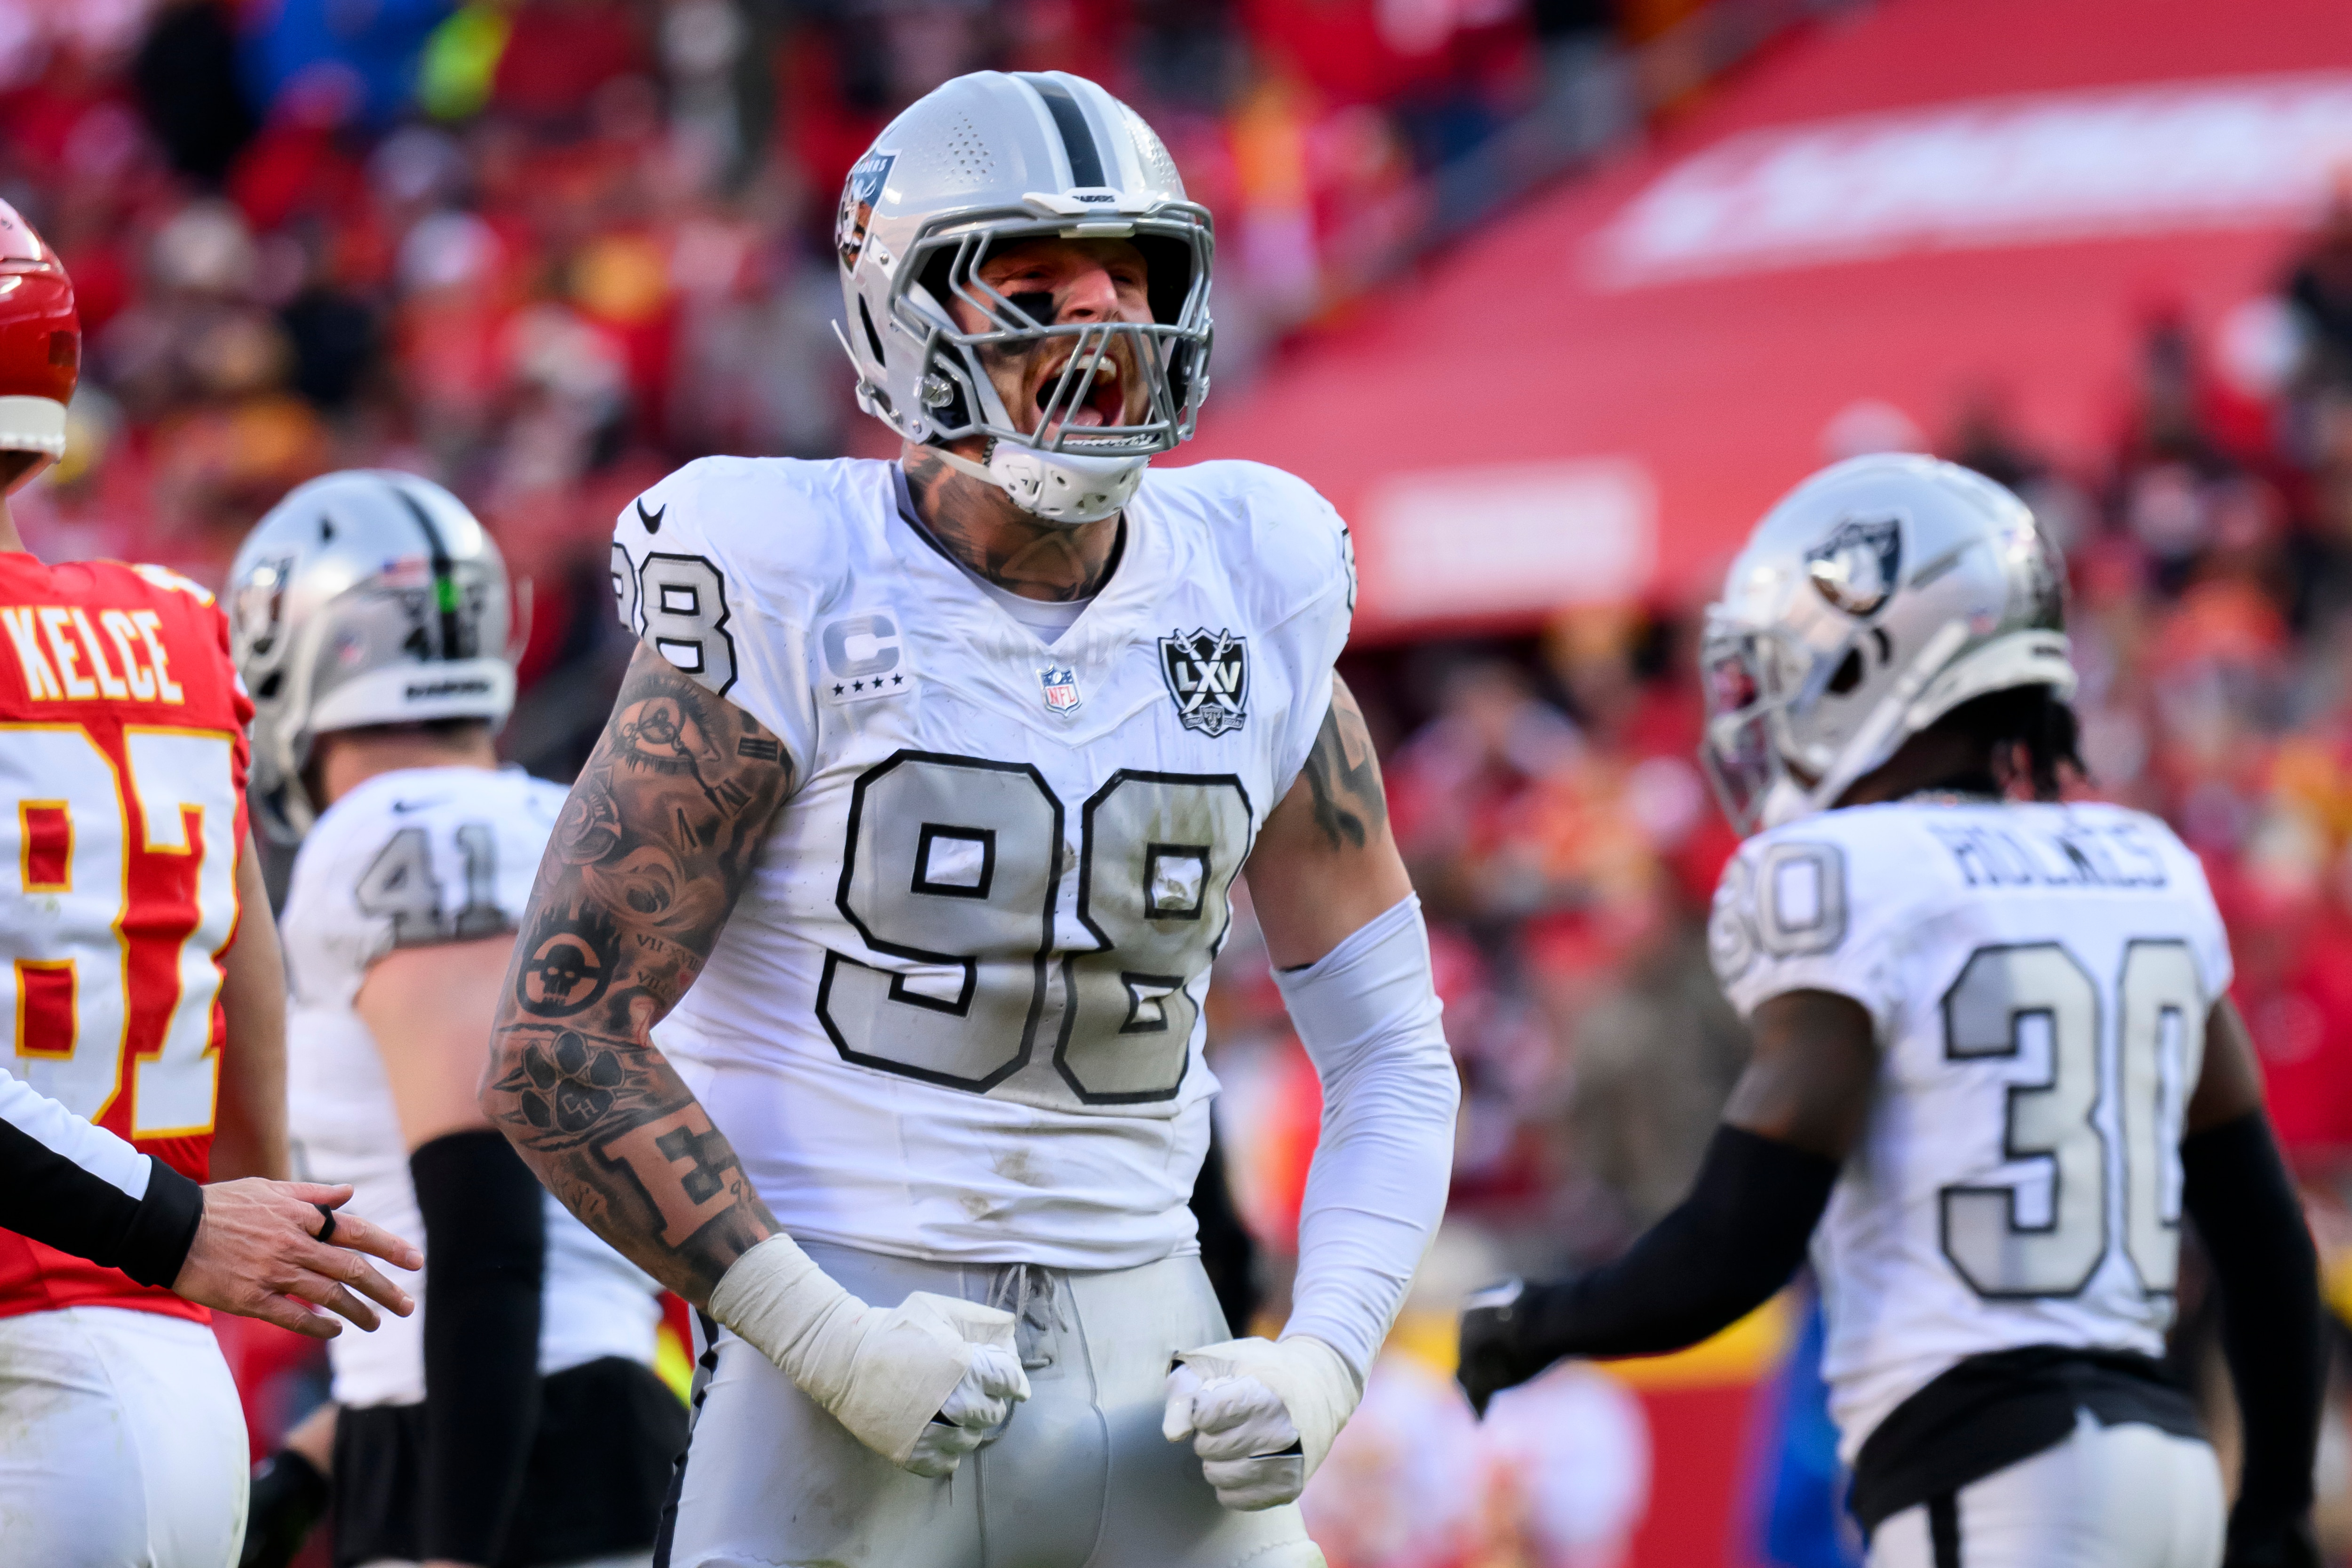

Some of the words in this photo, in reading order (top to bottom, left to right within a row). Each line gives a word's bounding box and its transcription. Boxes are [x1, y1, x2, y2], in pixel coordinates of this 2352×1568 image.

[1, 605, 185, 705] KELCE
[823, 614, 900, 679] C
[1047, 685, 1077, 707] NFL
[1179, 661, 1241, 693] LXV
[0, 721, 239, 1141] 87
[356, 825, 509, 940] 41
[815, 748, 1254, 1105] 98
[601, 1102, 712, 1241] E
[1940, 939, 2207, 1298] 30
